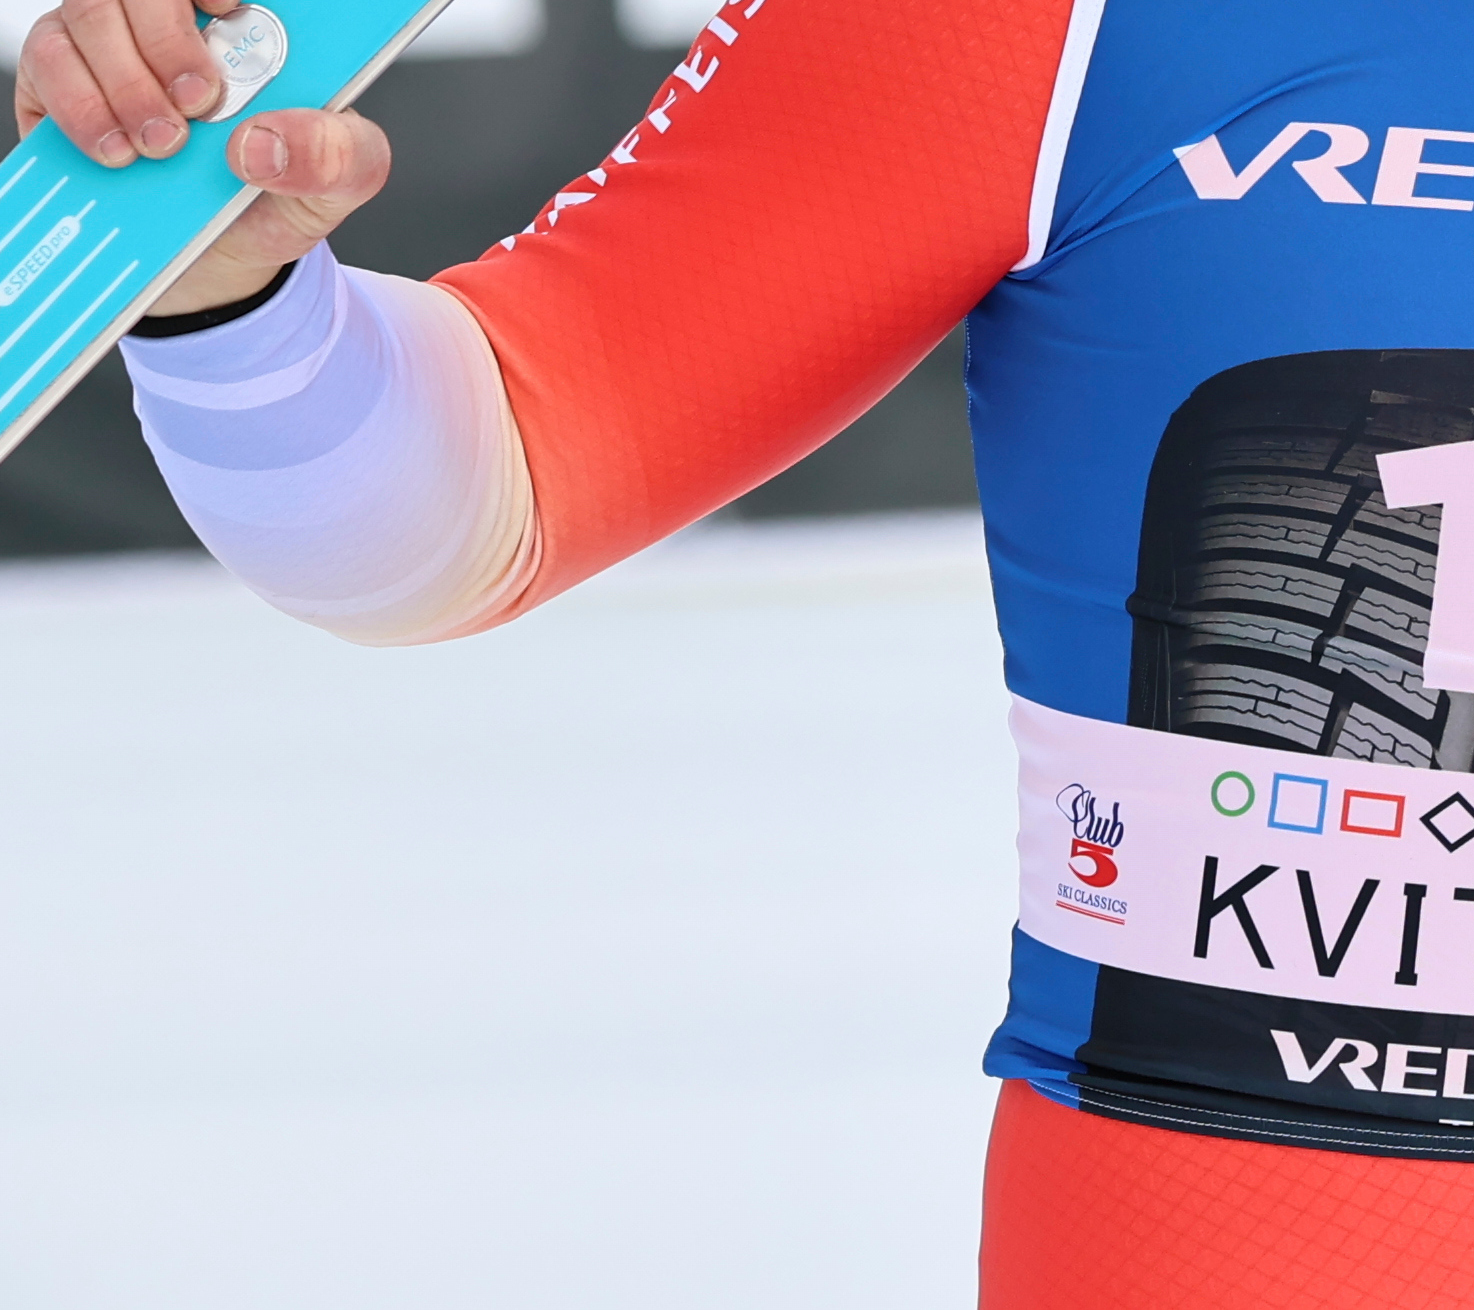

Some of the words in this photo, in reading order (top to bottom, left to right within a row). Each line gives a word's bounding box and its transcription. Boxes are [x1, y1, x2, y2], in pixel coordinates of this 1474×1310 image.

[223, 25, 266, 68] EMC
[1056, 783, 1125, 848] Club
[1068, 838, 1119, 888] 5
[1057, 883, 1072, 900] SKI
[1074, 889, 1128, 915] CLASSICS
